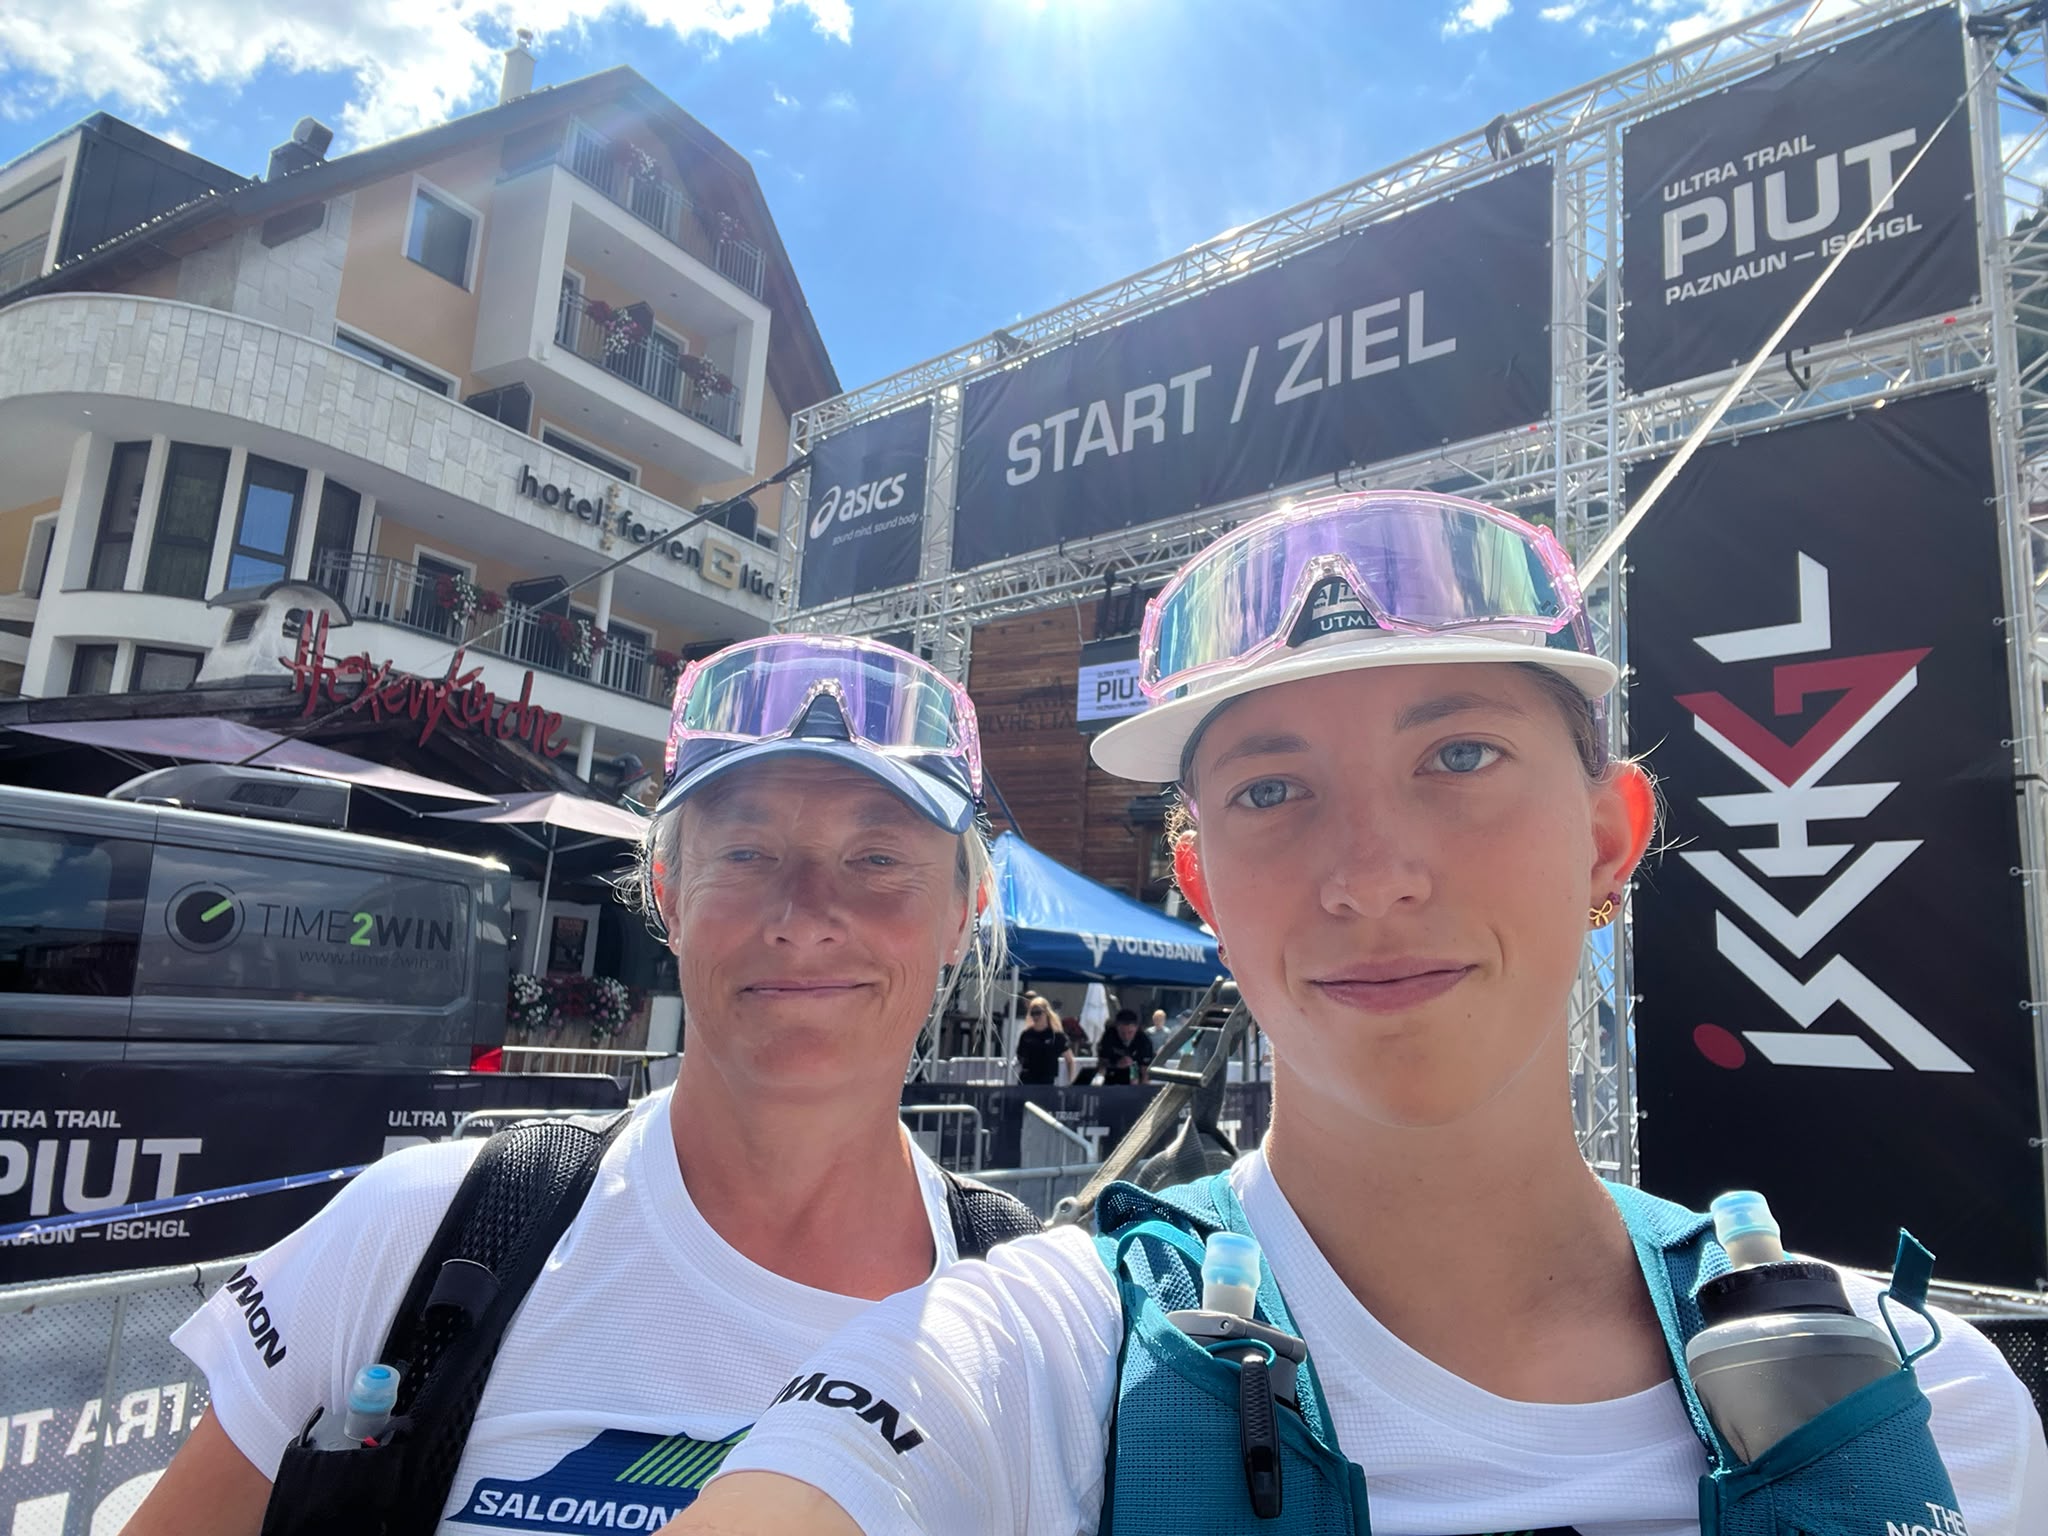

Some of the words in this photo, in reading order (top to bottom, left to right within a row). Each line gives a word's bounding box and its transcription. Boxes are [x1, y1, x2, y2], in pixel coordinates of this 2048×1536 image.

[1663, 166, 1738, 202] ULTRA
[1743, 134, 1816, 170] TRAIL
[1662, 127, 1917, 281] PIUT
[1665, 250, 1788, 305] PAZNAUN
[1821, 213, 1923, 257] ISCHGL
[1005, 365, 1212, 487] START
[1230, 346, 1259, 425] /
[1274, 290, 1457, 406] ZIEL
[519, 464, 603, 525] hotel
[256, 902, 453, 951] TIME2WIN
[1112, 935, 1206, 963] VOLKSBANK
[54, 1110, 121, 1128] TRAIL
[388, 1110, 447, 1128] ULTRA
[0, 1138, 202, 1216] PIUT
[106, 1219, 190, 1241] ISCHGL
[764, 1372, 924, 1455] MON
[473, 1490, 685, 1533] SALOMON
